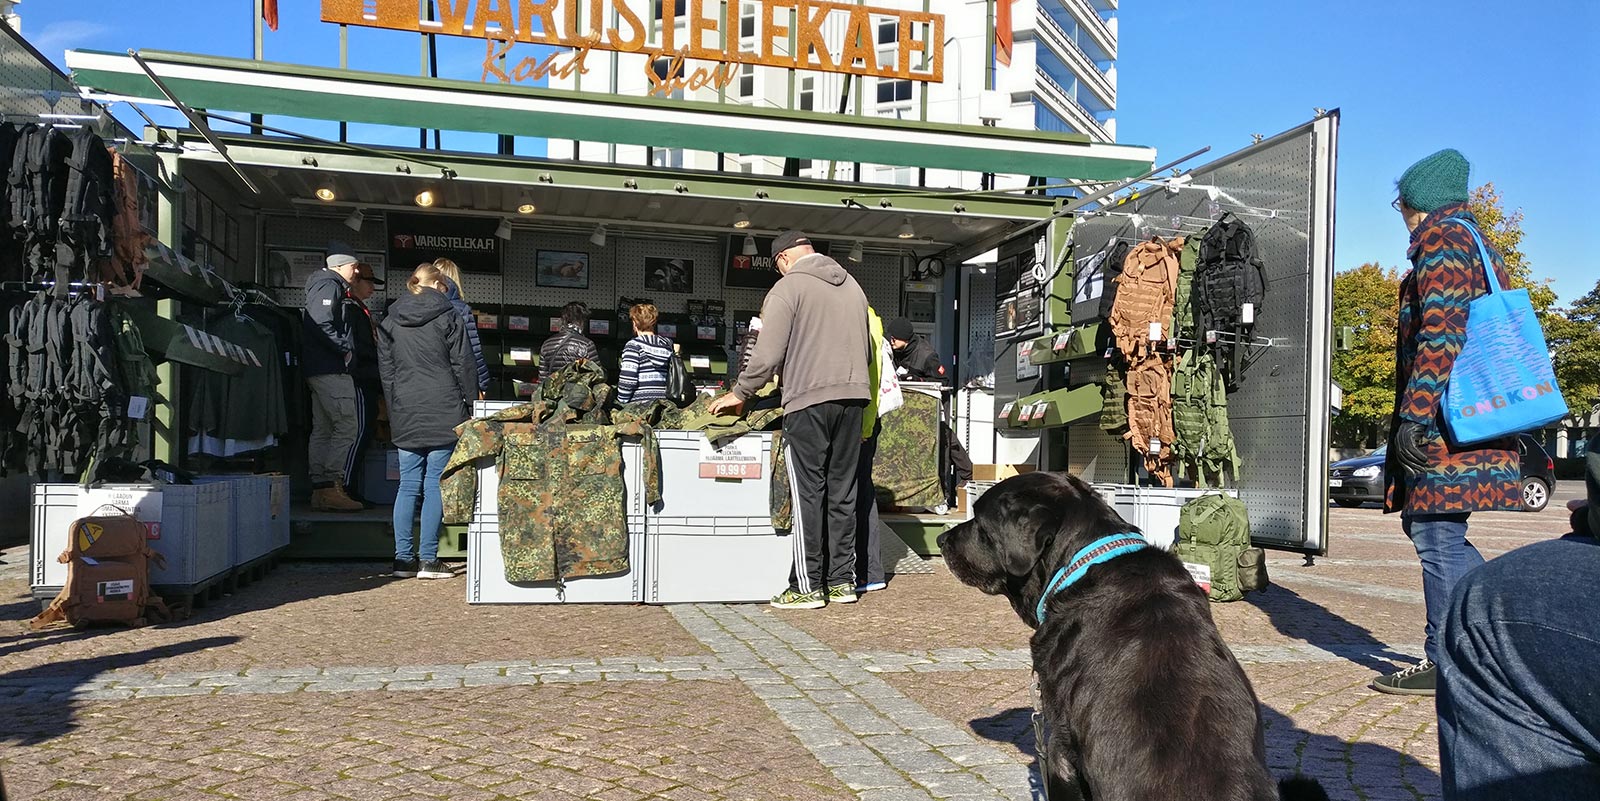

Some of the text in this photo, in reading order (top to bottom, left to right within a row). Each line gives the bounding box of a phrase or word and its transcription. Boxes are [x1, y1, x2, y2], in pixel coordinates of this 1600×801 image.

[482, 31, 741, 97] Road Show
[414, 235, 494, 250] VARUSTELEKA.FI
[716, 464, 739, 475] 19,99
